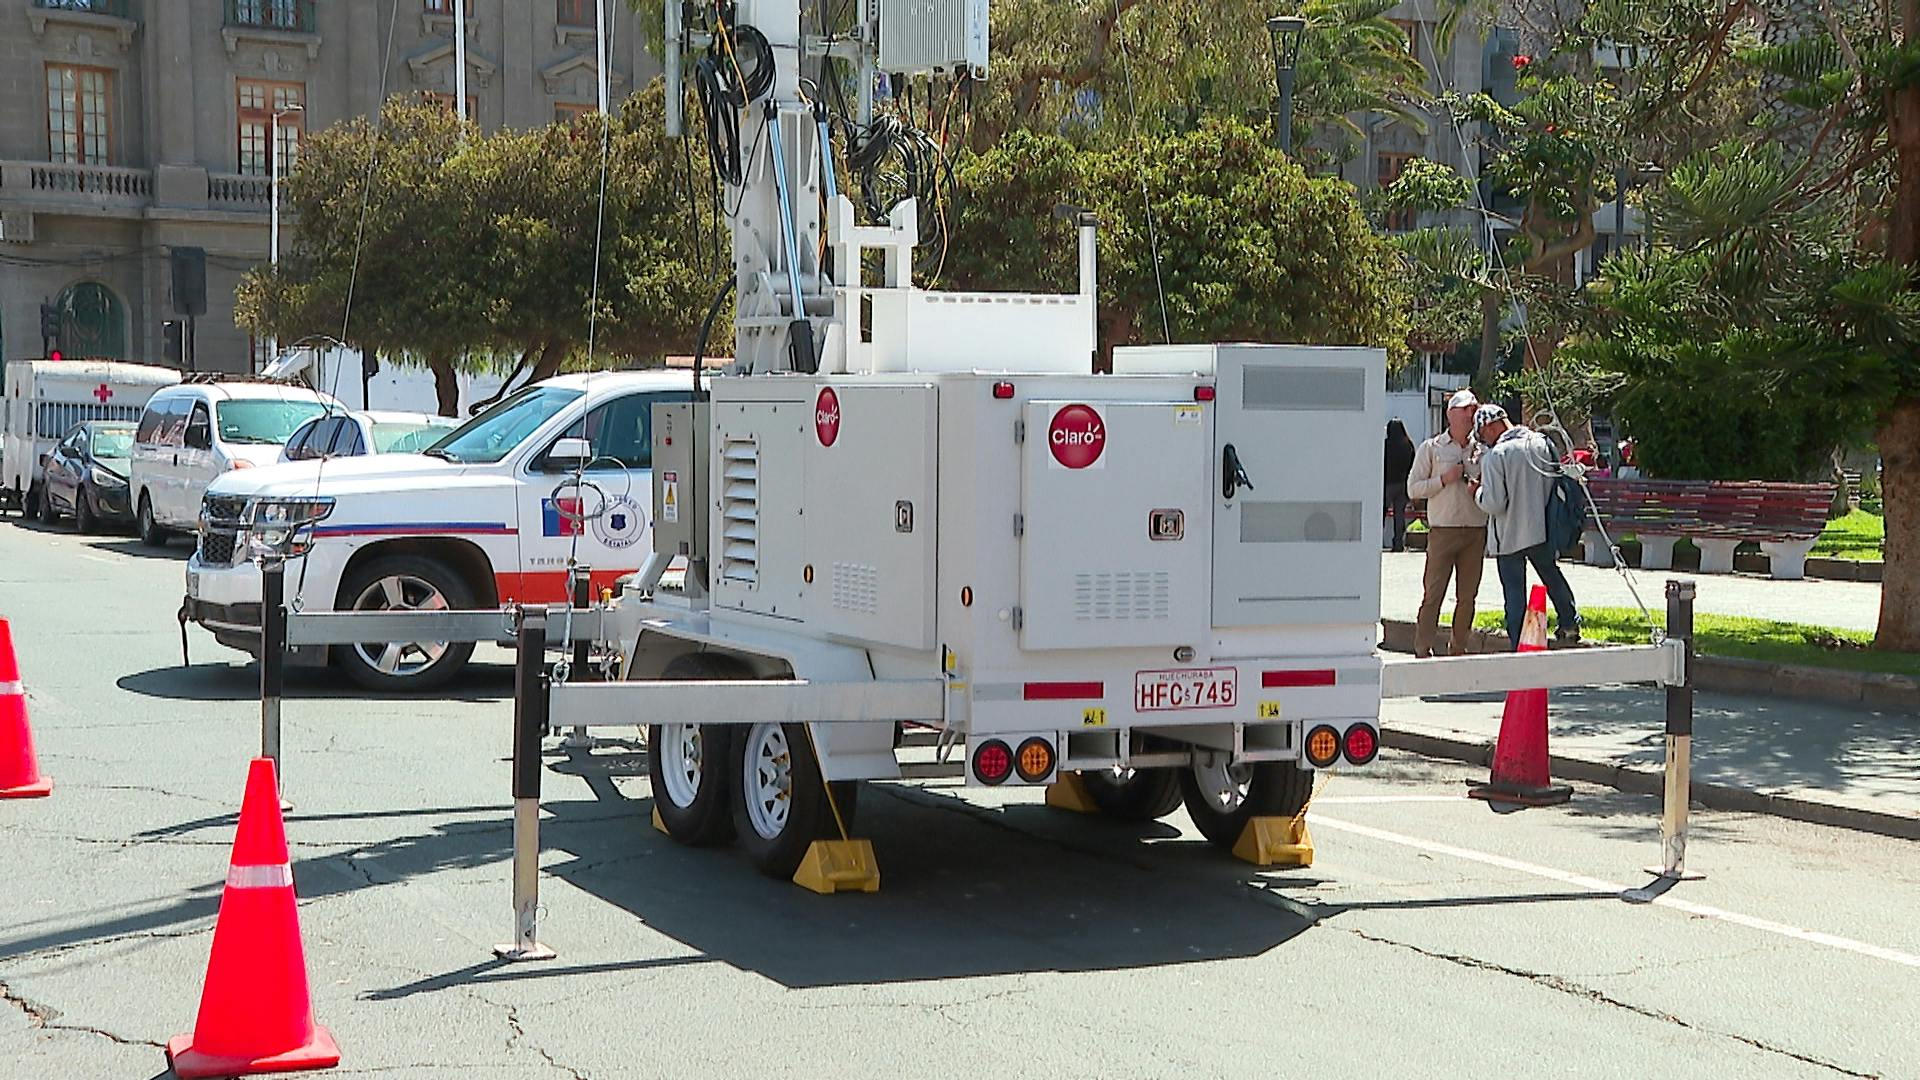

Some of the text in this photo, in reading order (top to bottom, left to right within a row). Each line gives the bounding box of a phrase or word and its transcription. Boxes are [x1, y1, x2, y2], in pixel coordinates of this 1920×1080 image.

[817, 405, 838, 424] Claro
[1052, 424, 1101, 445] Claro
[530, 558, 573, 566] TAHO
[1159, 671, 1214, 681] HUECHURABA
